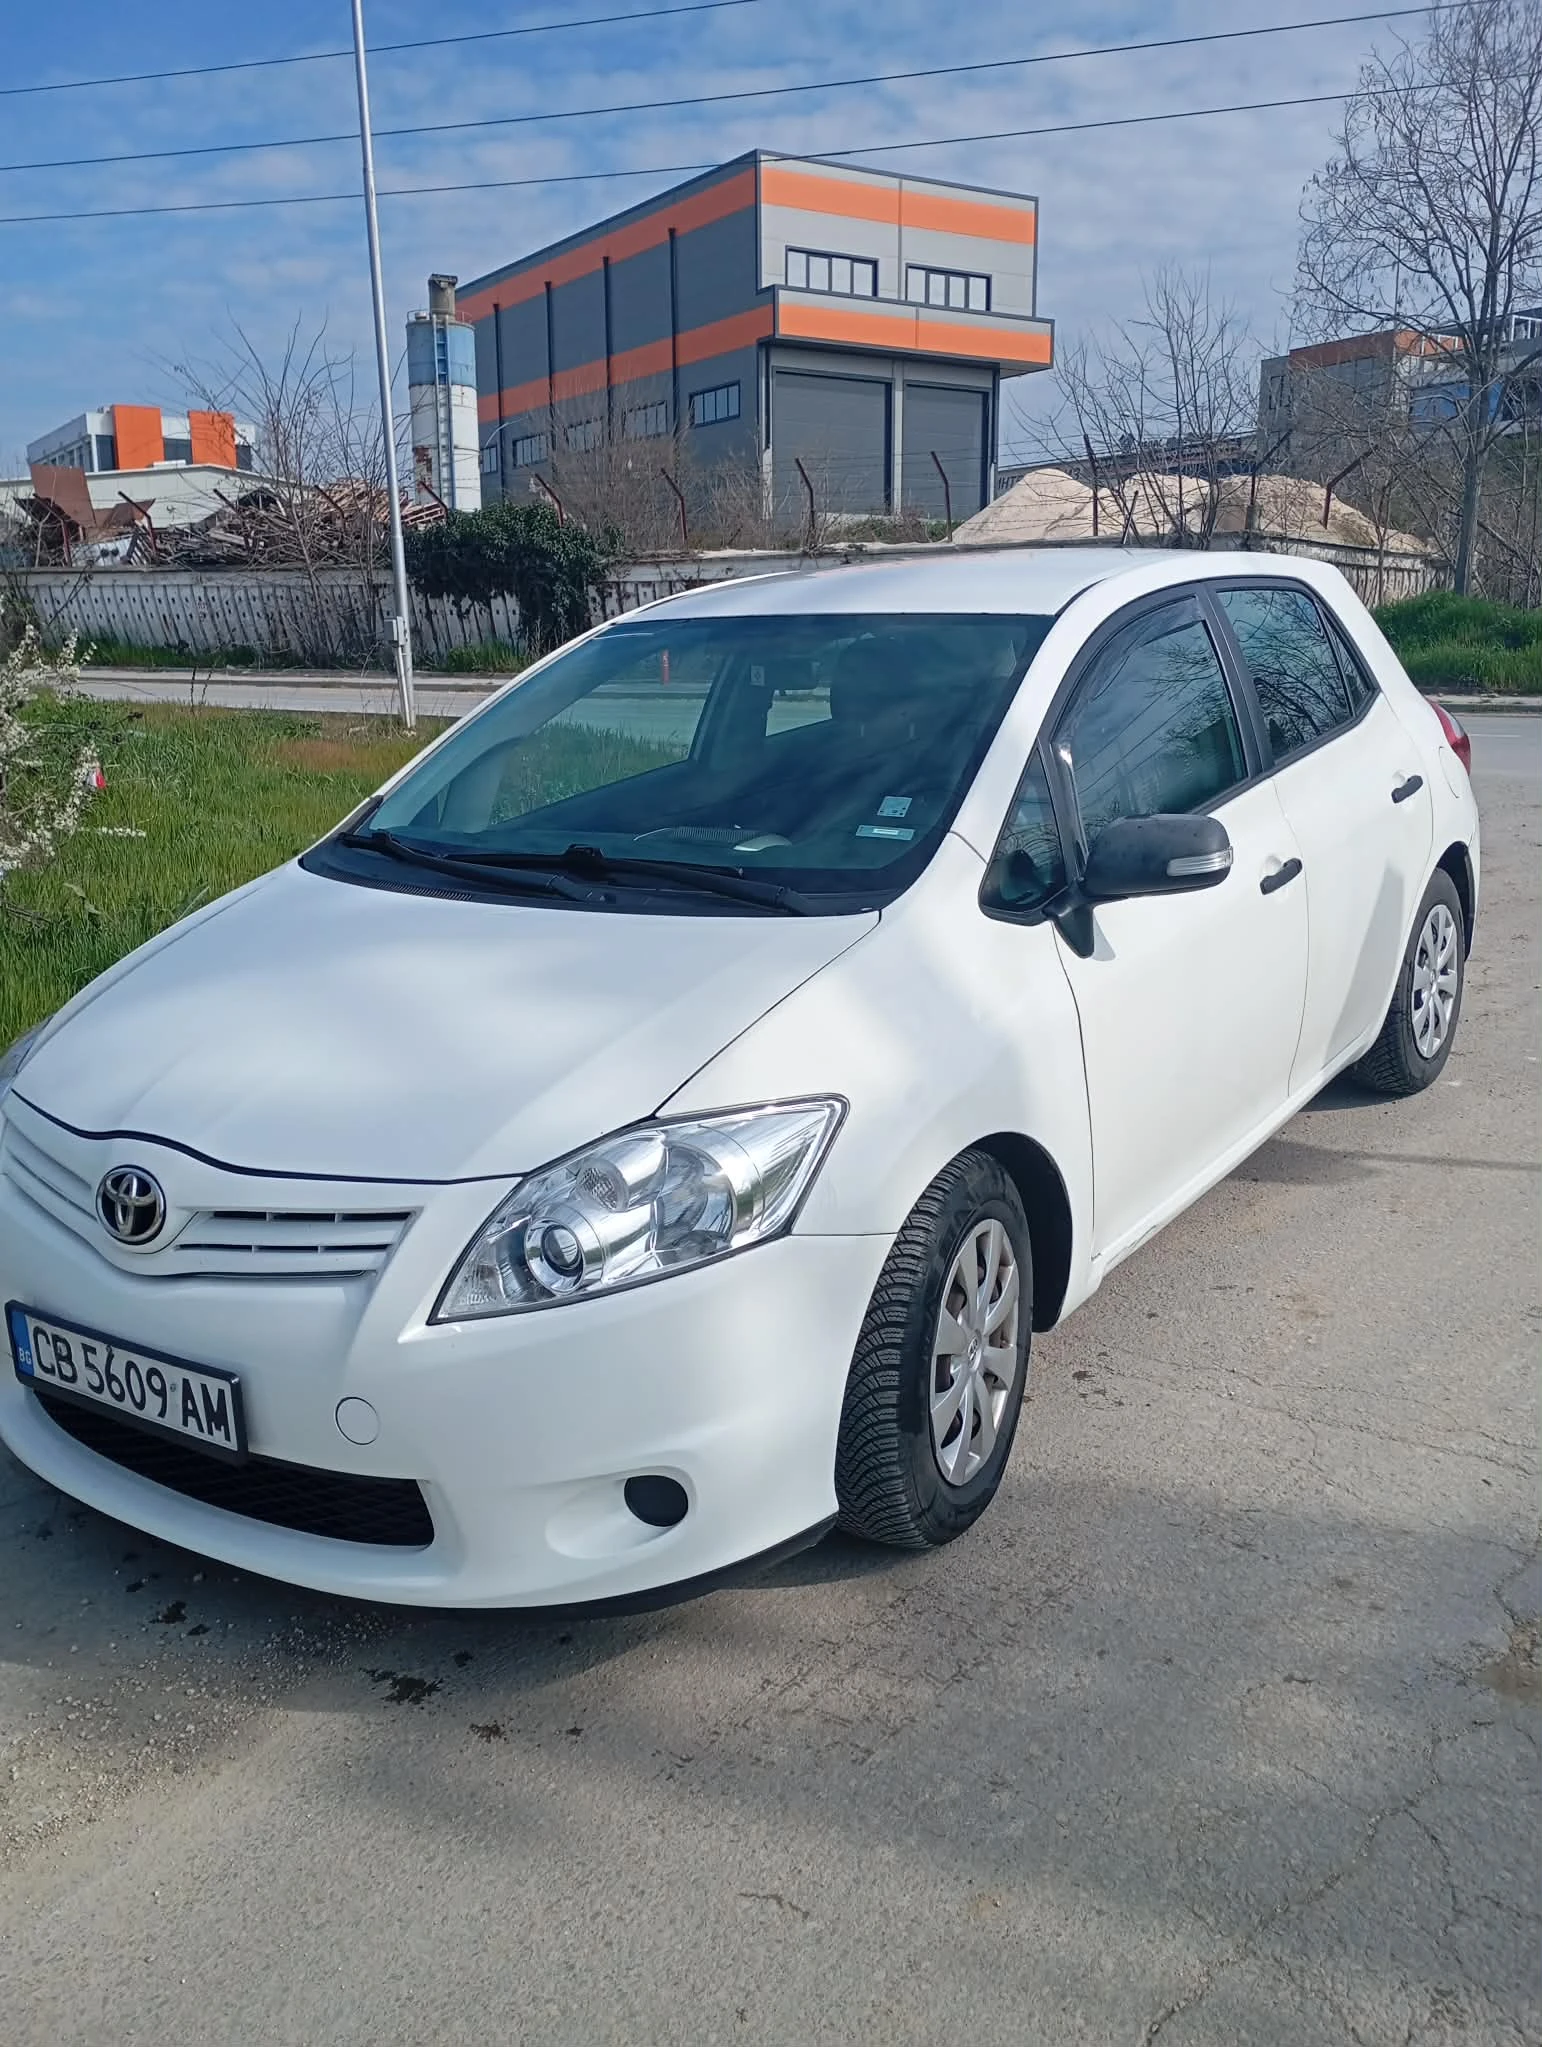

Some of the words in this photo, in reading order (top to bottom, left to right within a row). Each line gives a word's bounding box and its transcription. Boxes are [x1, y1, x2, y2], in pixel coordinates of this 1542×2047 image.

[19, 1347, 32, 1364] BG
[33, 1327, 77, 1383] CB
[82, 1343, 167, 1418] 5609
[181, 1378, 231, 1441] AM
